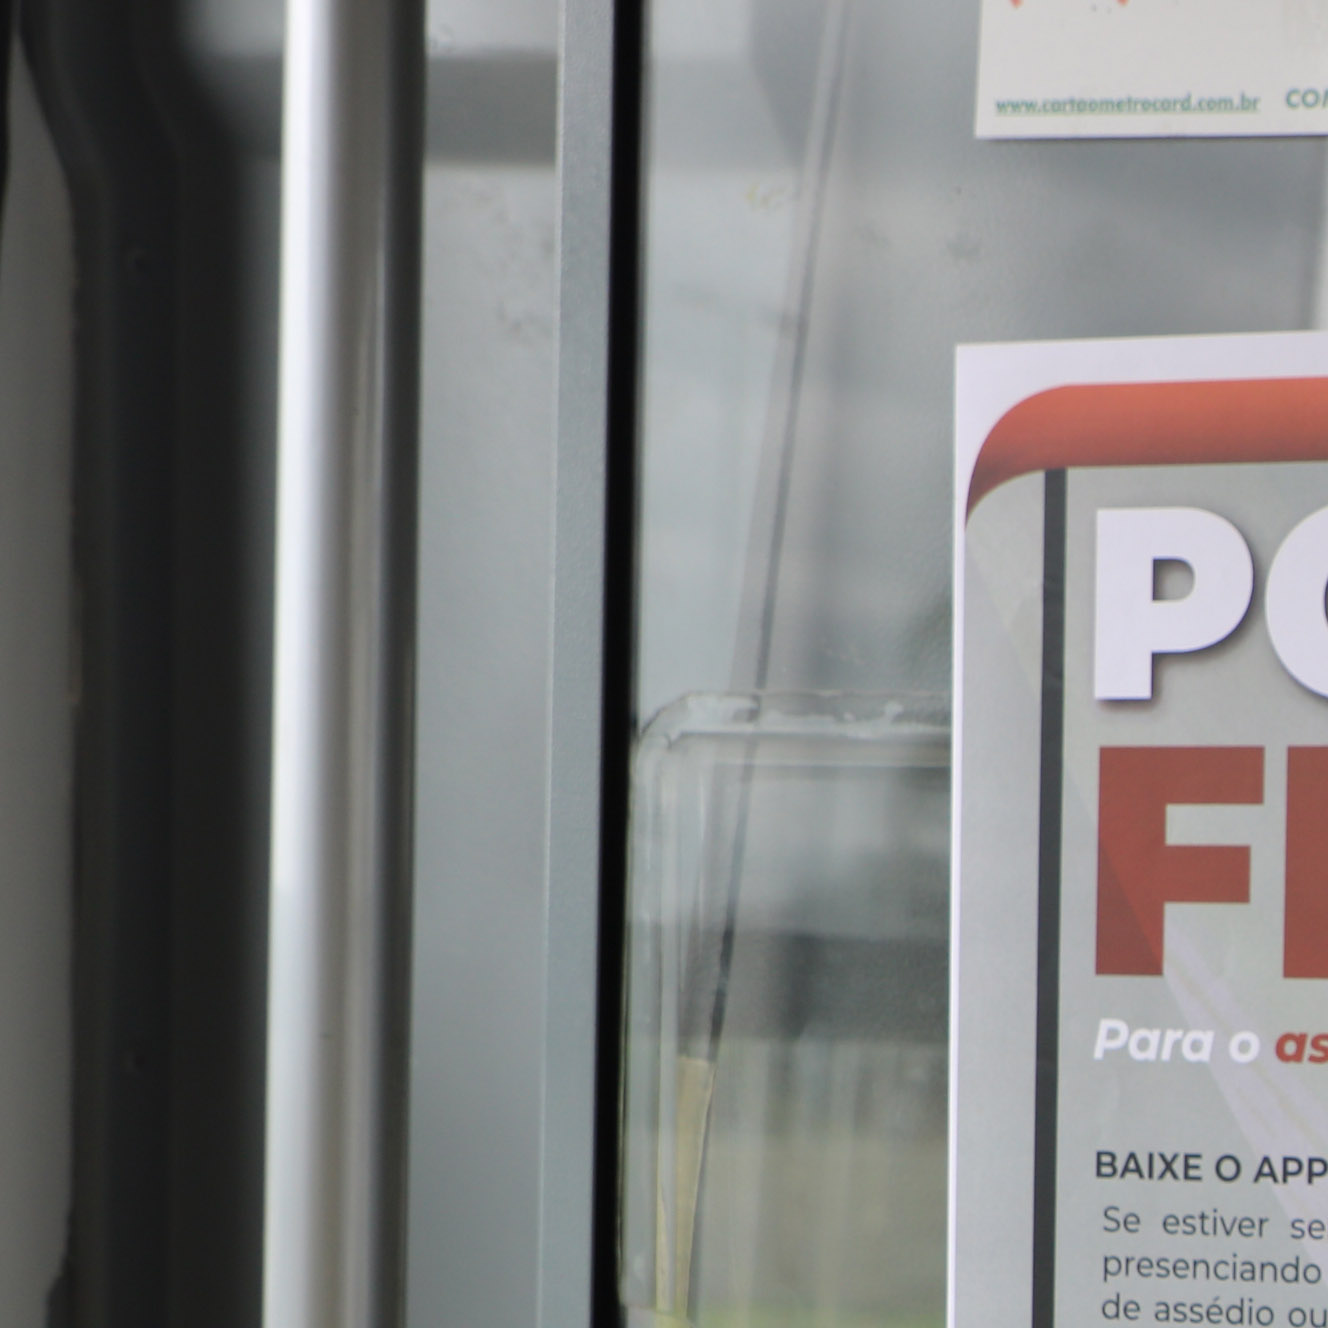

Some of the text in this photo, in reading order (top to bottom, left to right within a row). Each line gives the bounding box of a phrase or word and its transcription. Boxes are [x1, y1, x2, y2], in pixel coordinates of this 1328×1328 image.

[1092, 1018, 1215, 1064] Para
[1226, 1030, 1260, 1064] o
[1096, 1150, 1203, 1181] BAIXE
[1214, 1154, 1243, 1183] O
[1102, 1206, 1141, 1233] Se
[1162, 1209, 1269, 1238] estiver
[1103, 1252, 1322, 1284] presenciando
[1102, 1294, 1141, 1321] de
[1153, 1295, 1275, 1326] assédio
